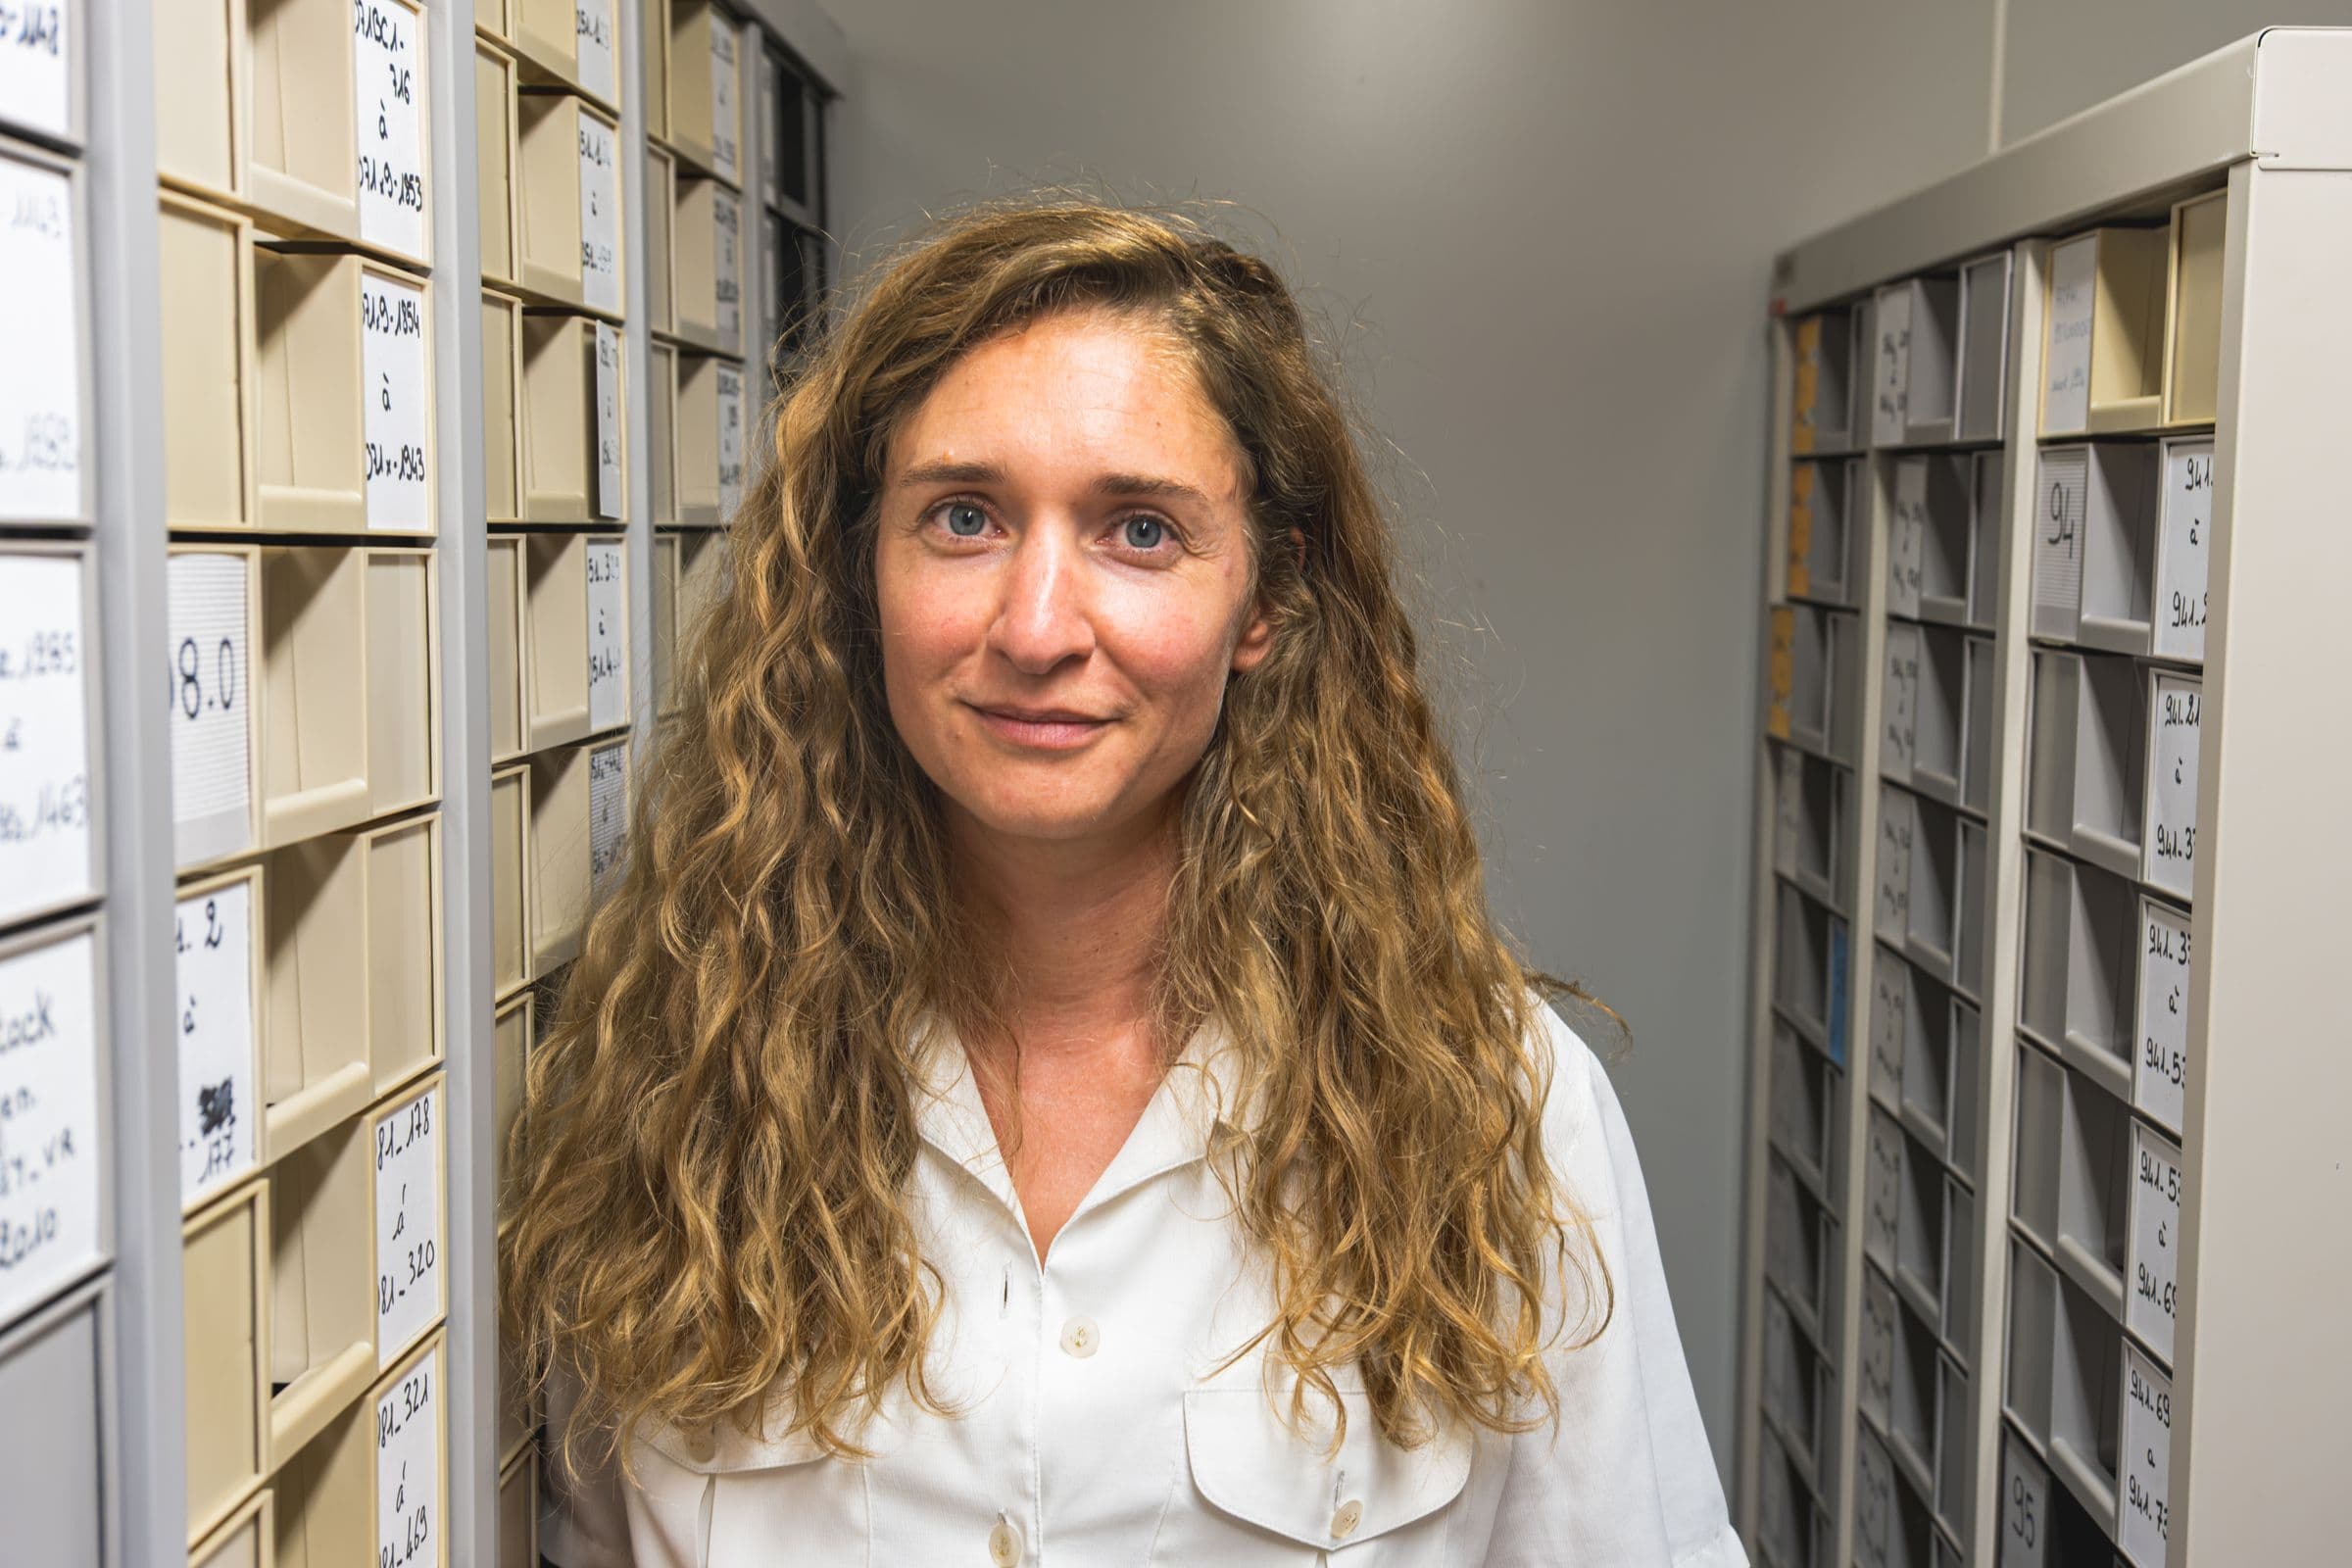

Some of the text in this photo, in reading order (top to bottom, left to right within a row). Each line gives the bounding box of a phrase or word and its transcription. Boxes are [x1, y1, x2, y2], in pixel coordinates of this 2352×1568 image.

[2047, 481, 2075, 561] 94
[2157, 823, 2196, 860] 941.3
[2012, 1475, 2035, 1549] 95
